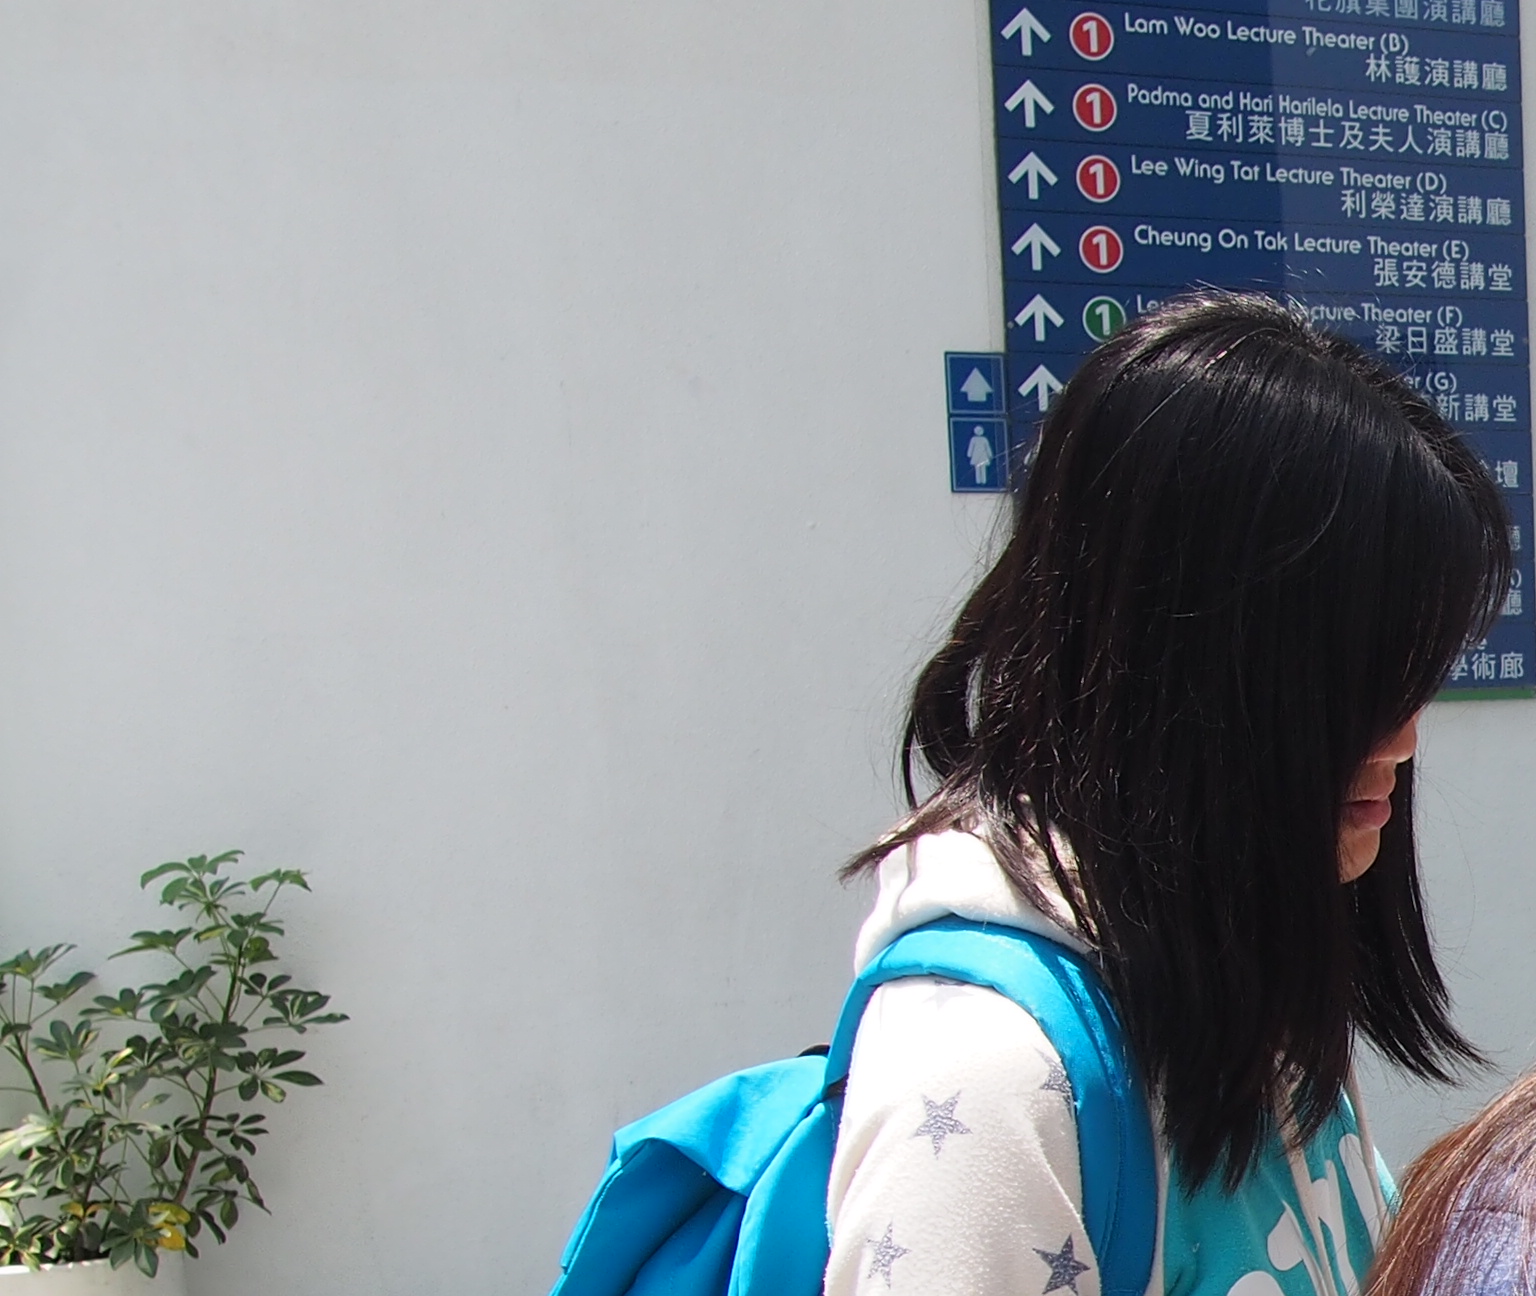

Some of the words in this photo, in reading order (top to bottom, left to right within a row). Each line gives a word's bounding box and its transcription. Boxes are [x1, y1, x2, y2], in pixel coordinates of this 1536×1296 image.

[1125, 12, 1168, 35] Lam
[1174, 16, 1221, 39] Woo
[1227, 20, 1296, 45] Lecture
[1302, 26, 1375, 50] Theater
[1379, 33, 1409, 56] (B)
[1365, 54, 1508, 92] 林護演講廳
[1127, 83, 1192, 107] Padma
[1198, 91, 1233, 110] and
[1240, 92, 1273, 113] Hari
[1279, 95, 1343, 118] Harilela
[1349, 100, 1409, 123] Lecture
[1413, 104, 1477, 127] Theater
[1481, 110, 1508, 132] (C)
[1185, 110, 1510, 160] 夏利萊博士及夫人演講廳
[1131, 155, 1167, 176] Lee
[1174, 157, 1224, 184] Wing
[1231, 160, 1263, 182] Tat
[1265, 162, 1334, 186] Lecture
[1340, 167, 1411, 190] Theater
[1416, 172, 1447, 194] (D)
[1341, 190, 1512, 226] 利榮達演講廳
[1134, 225, 1212, 252] Cheung
[1218, 229, 1248, 250] On
[1254, 230, 1289, 251] Tak
[1294, 232, 1361, 255] Lecture
[1367, 236, 1438, 257] Theater
[1443, 237, 1469, 261] (E)
[1373, 258, 1513, 292] 張安德講堂
[1361, 303, 1432, 324] Theater
[1437, 306, 1463, 328] (F)
[1375, 324, 1515, 357] 梁日盛講堂
[1426, 371, 1457, 393] (G)
